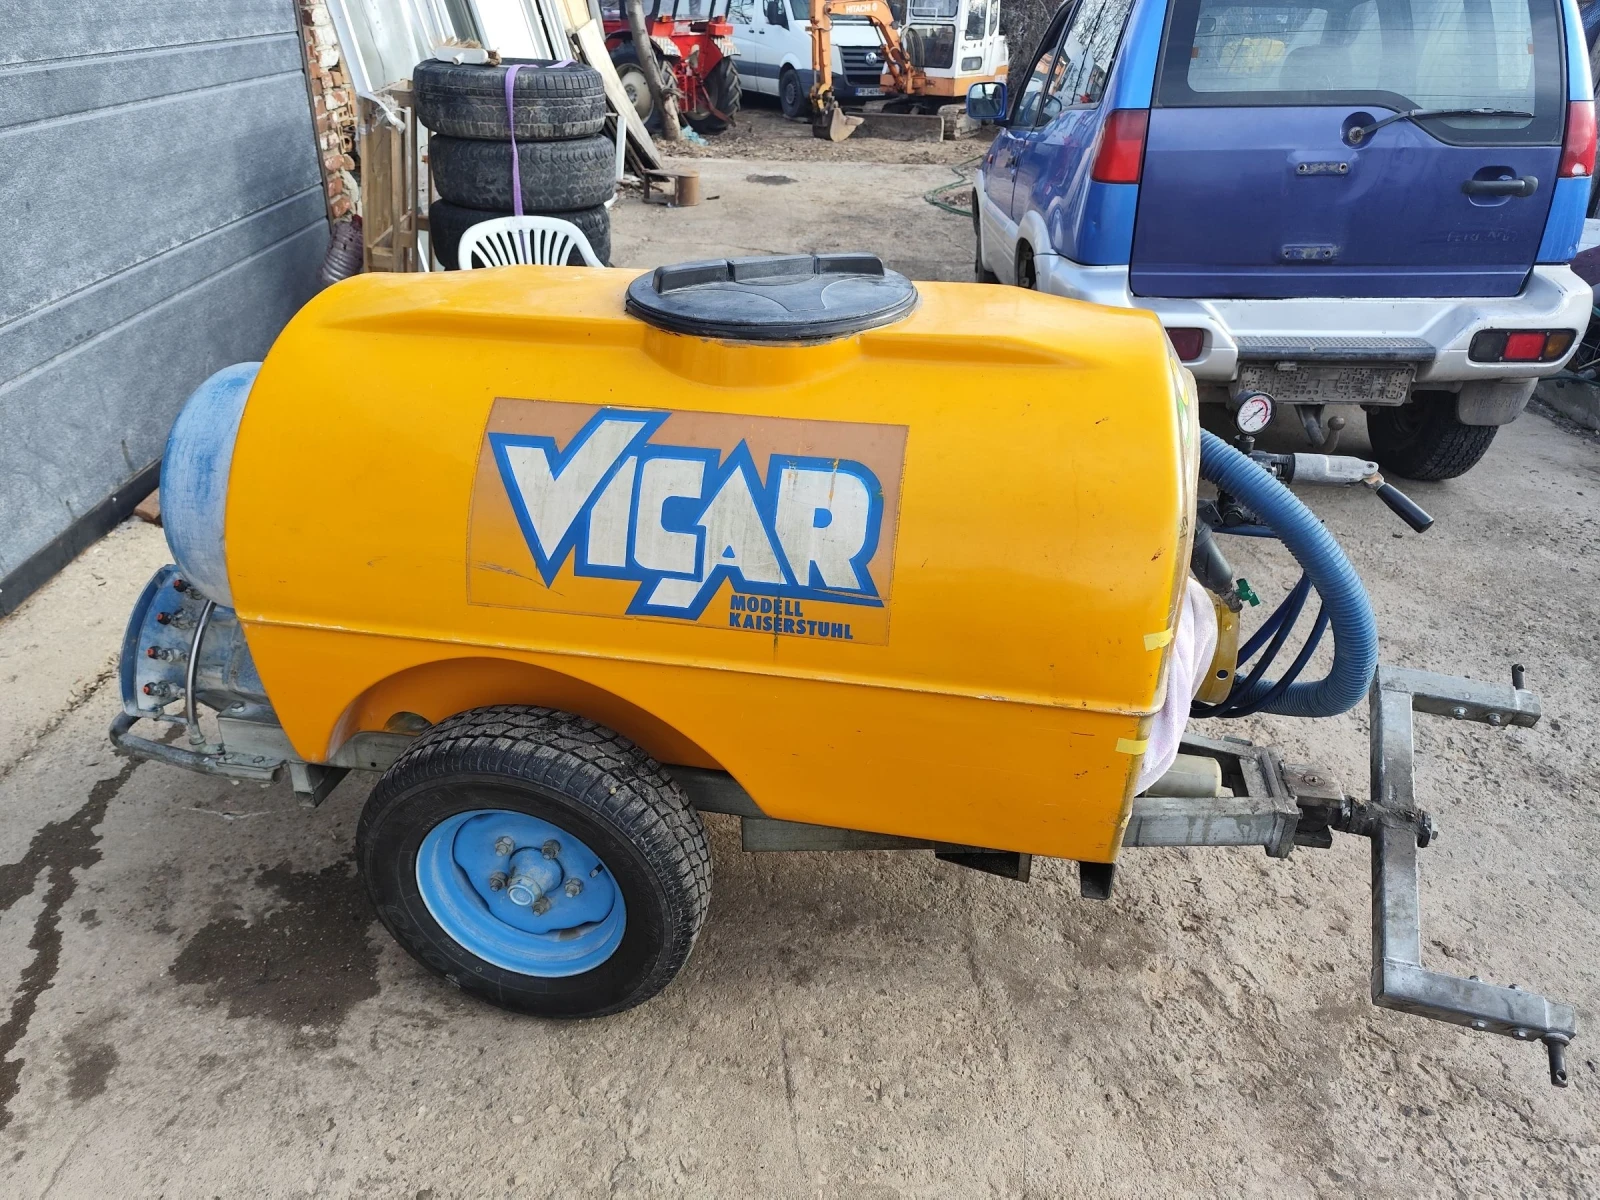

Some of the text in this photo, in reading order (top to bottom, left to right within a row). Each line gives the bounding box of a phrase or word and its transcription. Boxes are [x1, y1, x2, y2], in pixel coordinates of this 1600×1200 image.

[845, 3, 871, 14] HITACHI
[488, 408, 884, 620] VICAR
[730, 594, 803, 617] MODELL
[729, 611, 853, 639] KAISERSTUHL
